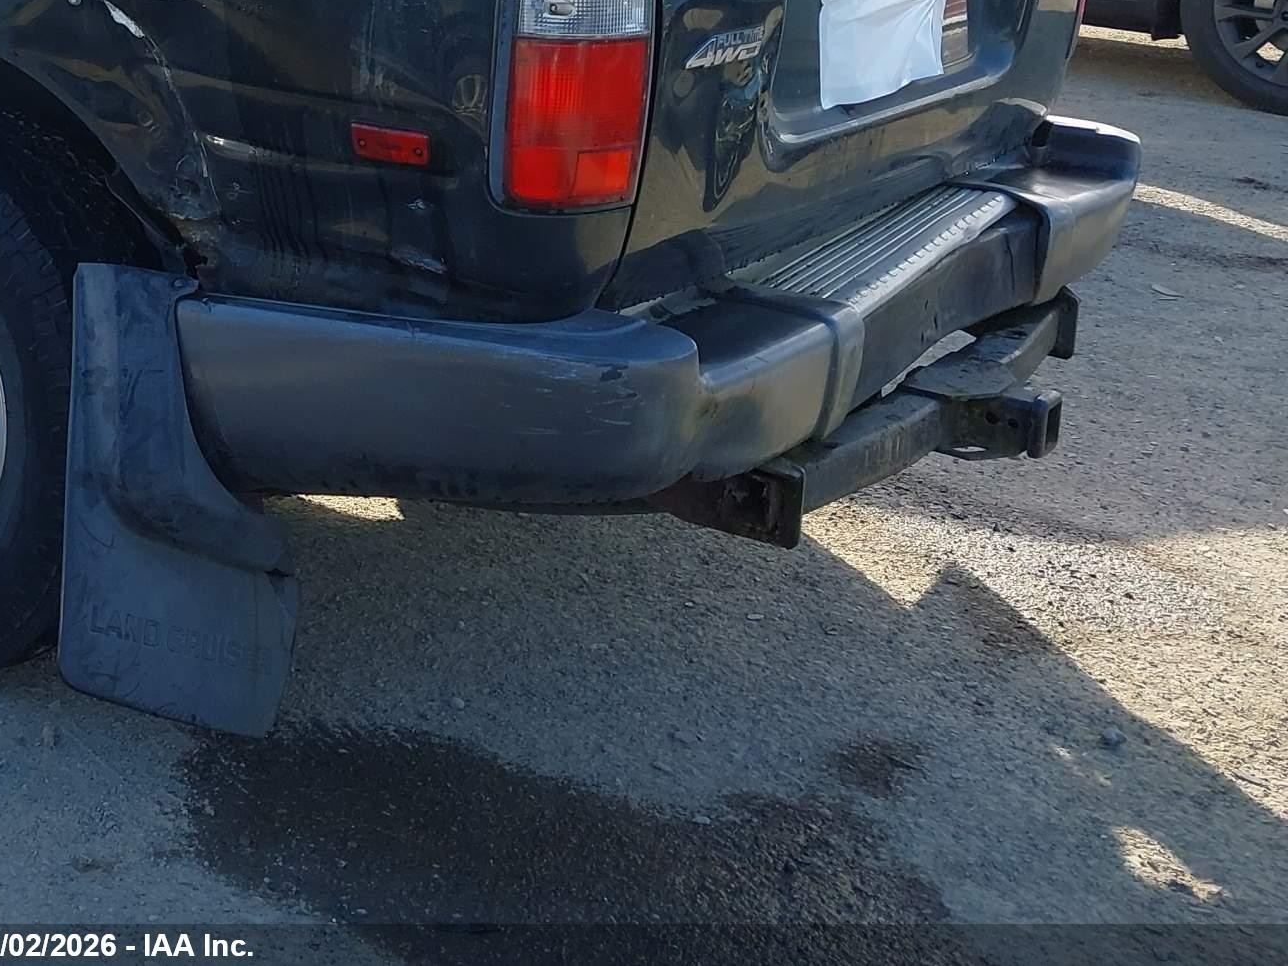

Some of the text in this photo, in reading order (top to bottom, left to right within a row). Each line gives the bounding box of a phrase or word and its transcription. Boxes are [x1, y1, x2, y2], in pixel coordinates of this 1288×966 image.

[685, 37, 762, 70] 4WD
[716, 33, 742, 48] FULL
[89, 604, 161, 648] LAND
